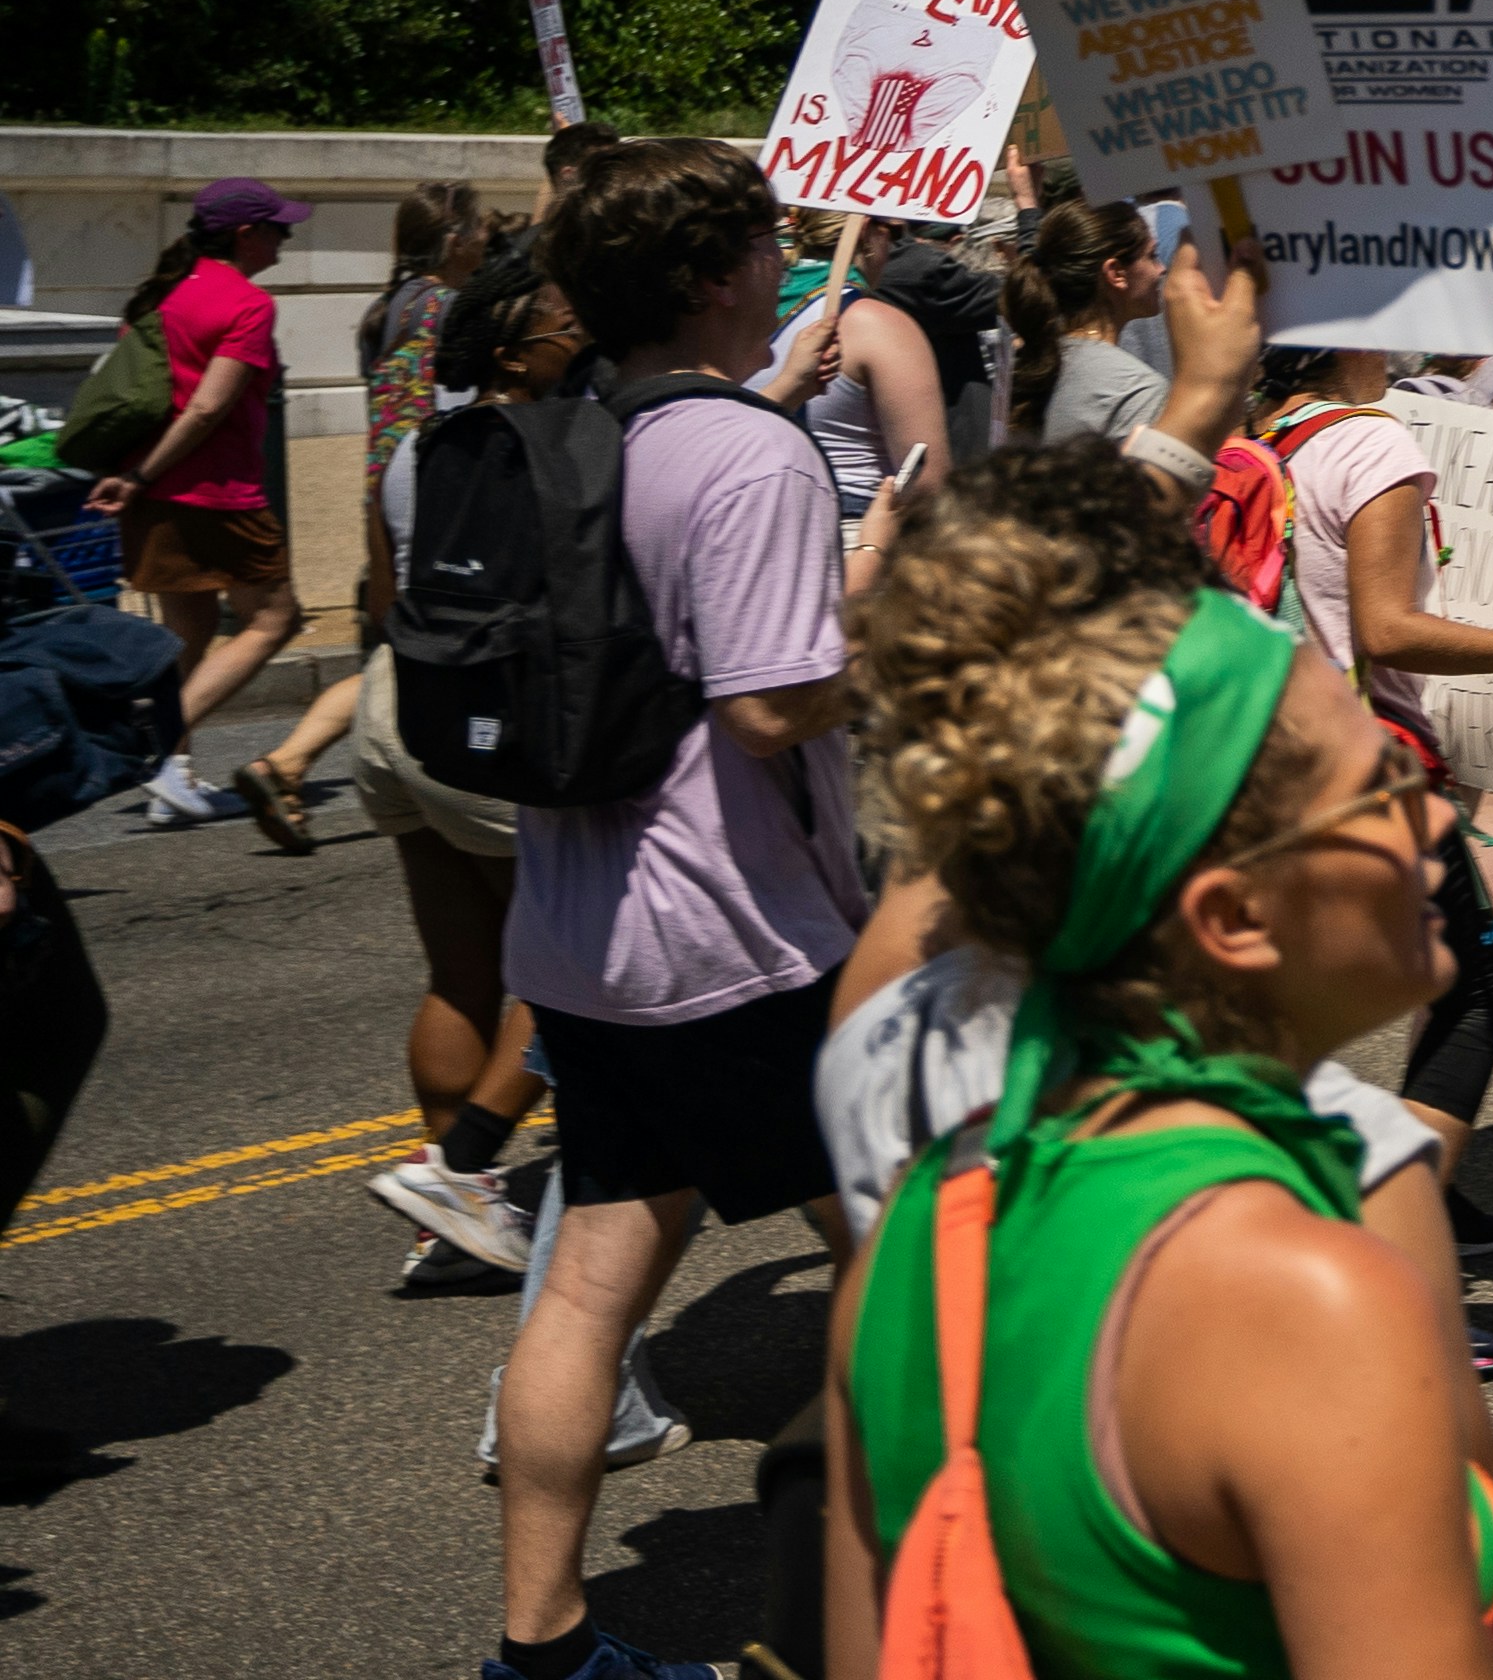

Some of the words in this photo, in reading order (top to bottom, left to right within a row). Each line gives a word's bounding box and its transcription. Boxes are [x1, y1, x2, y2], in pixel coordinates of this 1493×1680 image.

[1110, 27, 1255, 84] JUSTICE
[1325, 59, 1489, 76] ANIZATION
[792, 93, 828, 125] IS
[1103, 76, 1221, 120] WHEN
[1221, 61, 1275, 95] DO
[1369, 85, 1462, 99] WOMEN
[1089, 121, 1154, 156] WE
[1152, 96, 1260, 141] WANT
[1261, 85, 1309, 120] IT?
[1162, 125, 1263, 172] NOW!
